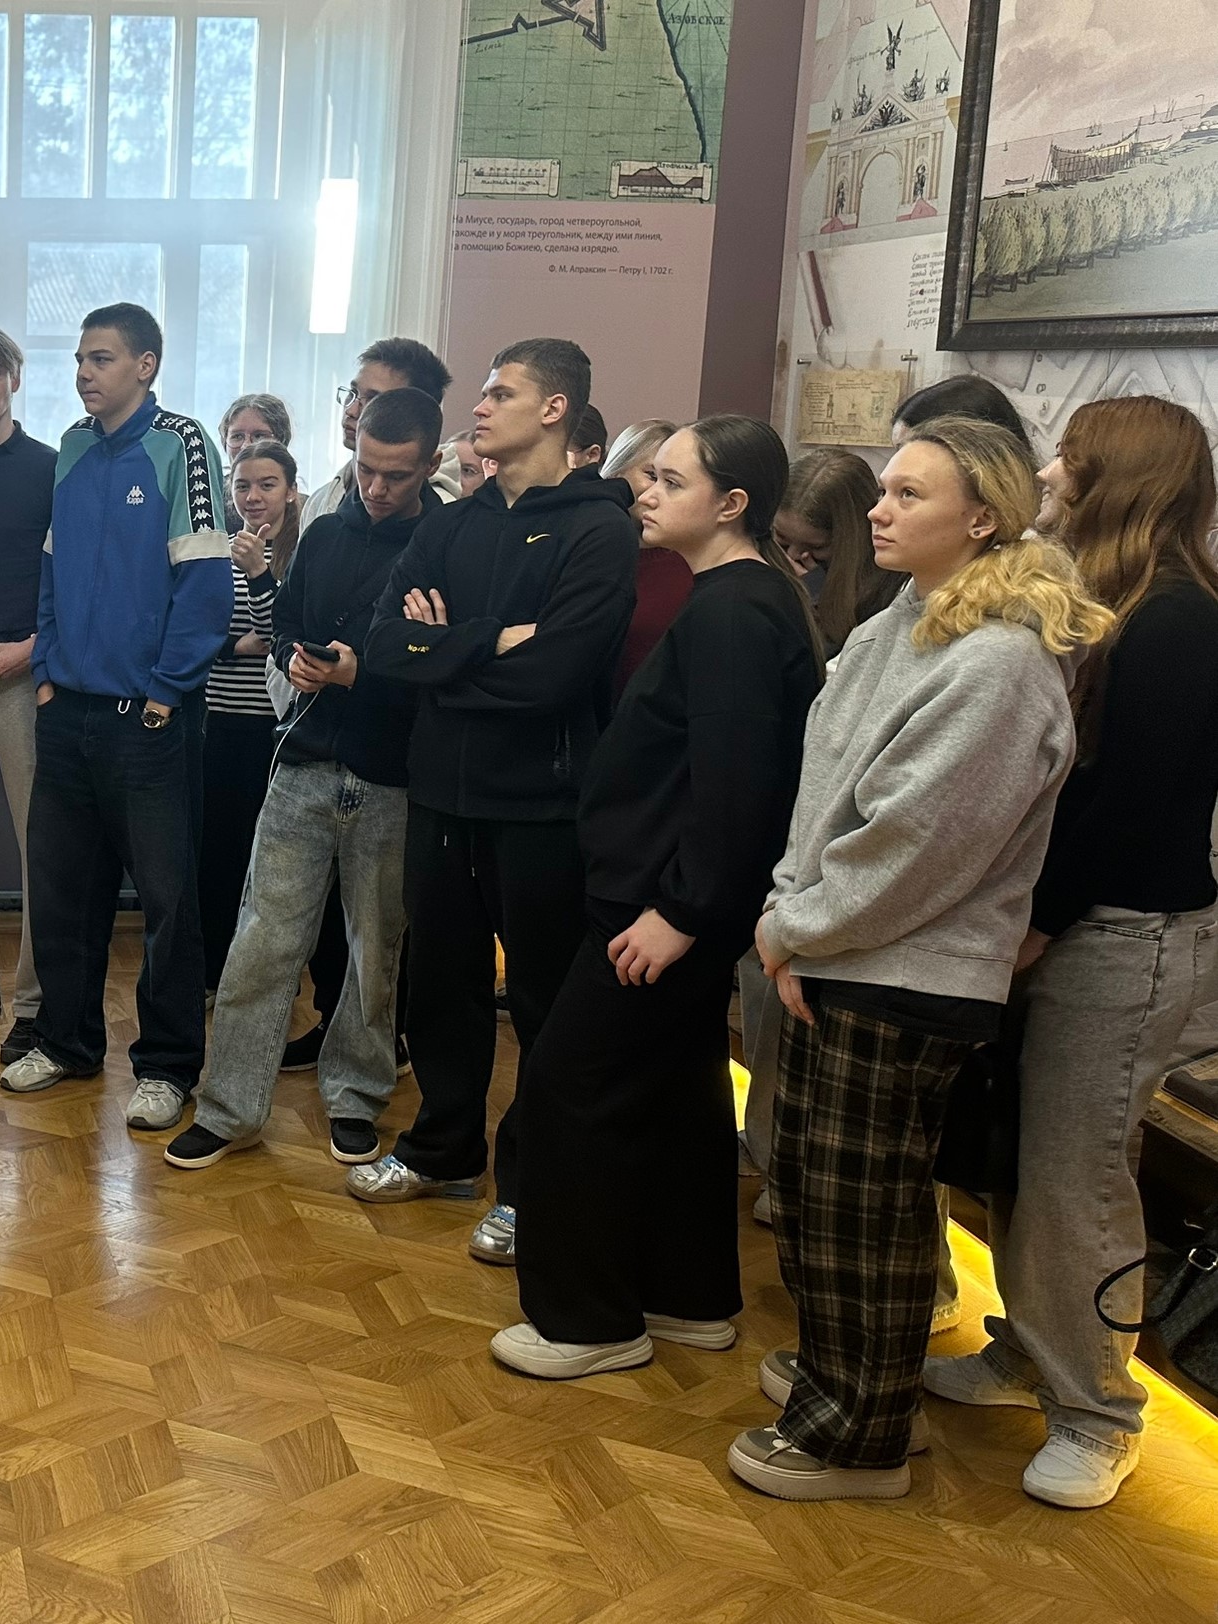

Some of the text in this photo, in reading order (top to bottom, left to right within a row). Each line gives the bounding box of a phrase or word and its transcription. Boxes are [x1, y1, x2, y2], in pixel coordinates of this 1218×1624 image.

[465, 215, 495, 226] Миусе,
[497, 217, 537, 227] государь,
[539, 217, 564, 226] город
[566, 217, 643, 228] четвероугольной,
[496, 231, 502, 239] у
[503, 231, 526, 239] моря
[528, 231, 583, 240] треугольник,
[585, 232, 614, 241] между
[634, 233, 663, 241] линия,
[461, 243, 504, 252] помощию
[506, 242, 542, 252] Божиею,
[544, 244, 580, 253] сделана
[581, 245, 620, 254] изрядно.
[548, 264, 558, 273] Ф.
[559, 265, 568, 273] М.
[570, 265, 607, 274] Апраксин
[619, 265, 642, 275] Петру
[650, 266, 668, 274] 1702
